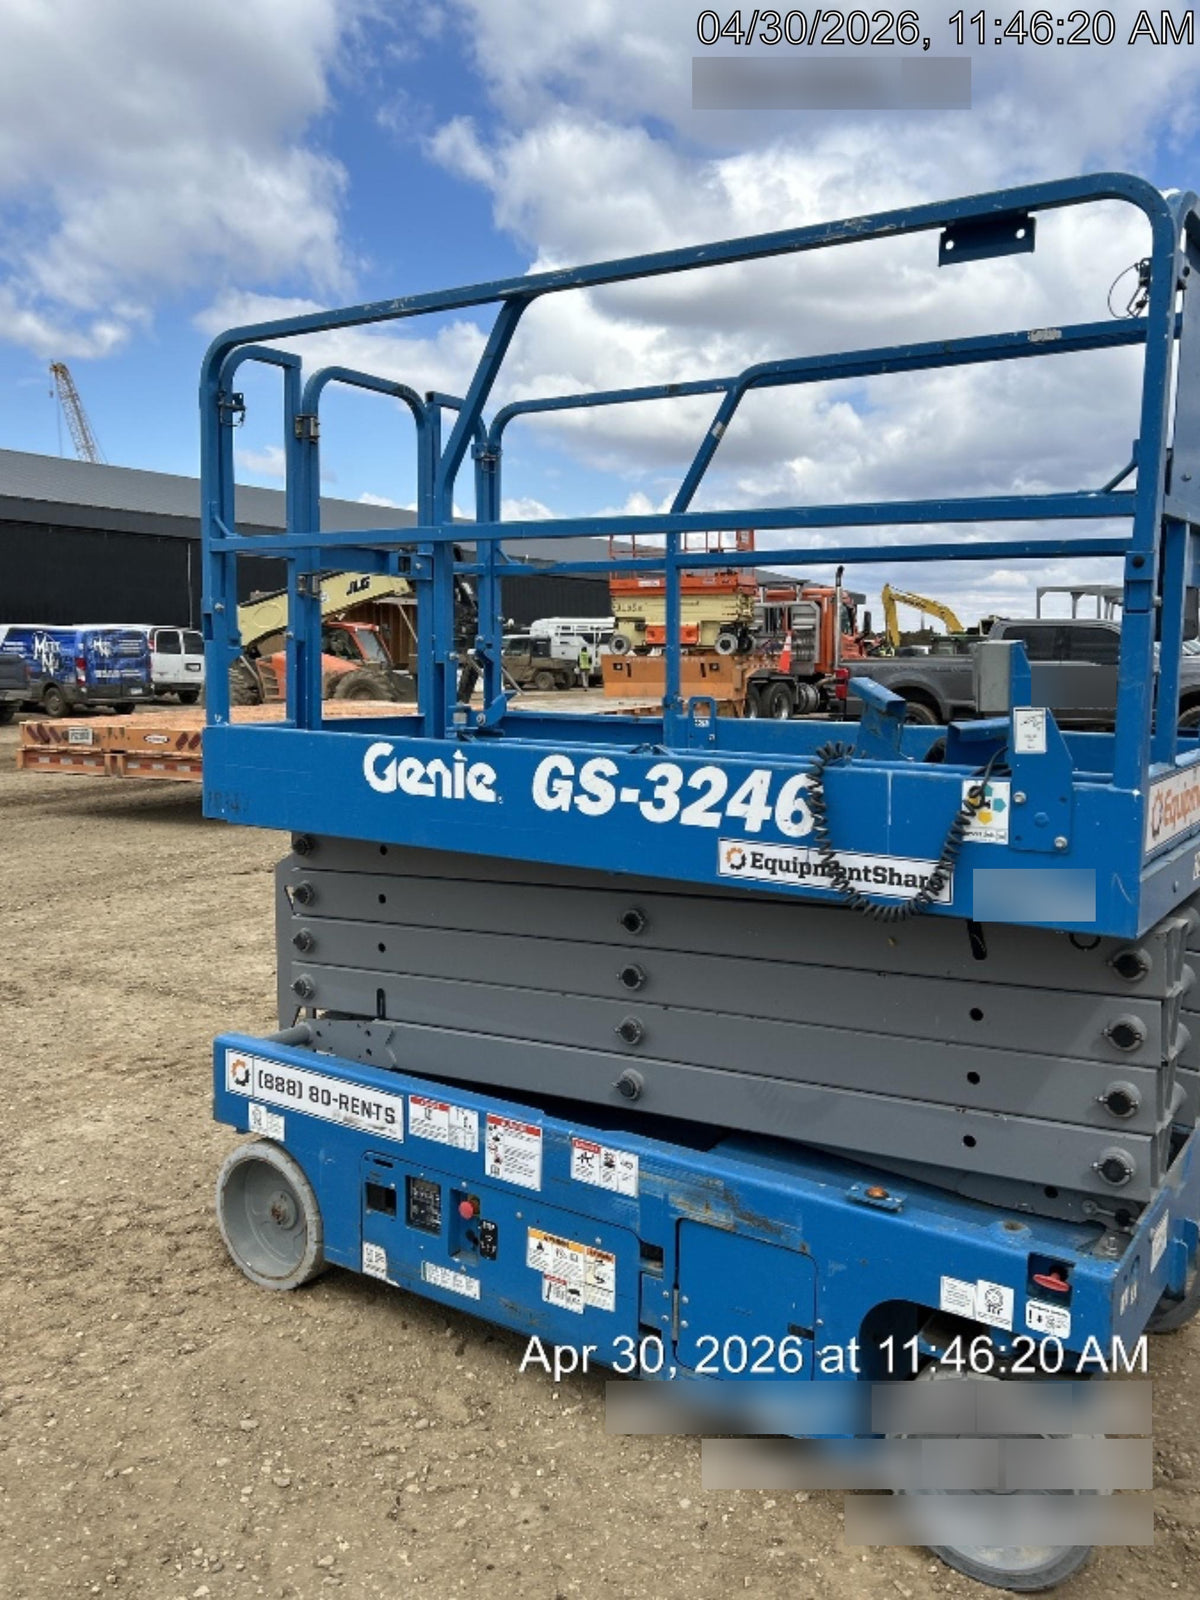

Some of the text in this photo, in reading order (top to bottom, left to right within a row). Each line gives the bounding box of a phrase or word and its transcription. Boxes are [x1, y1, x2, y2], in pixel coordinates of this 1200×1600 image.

[346, 575, 370, 596] JLG
[363, 741, 824, 838] Genie GS-3246
[258, 1069, 303, 1099] (888)
[308, 1085, 397, 1125] 80-RENTS
